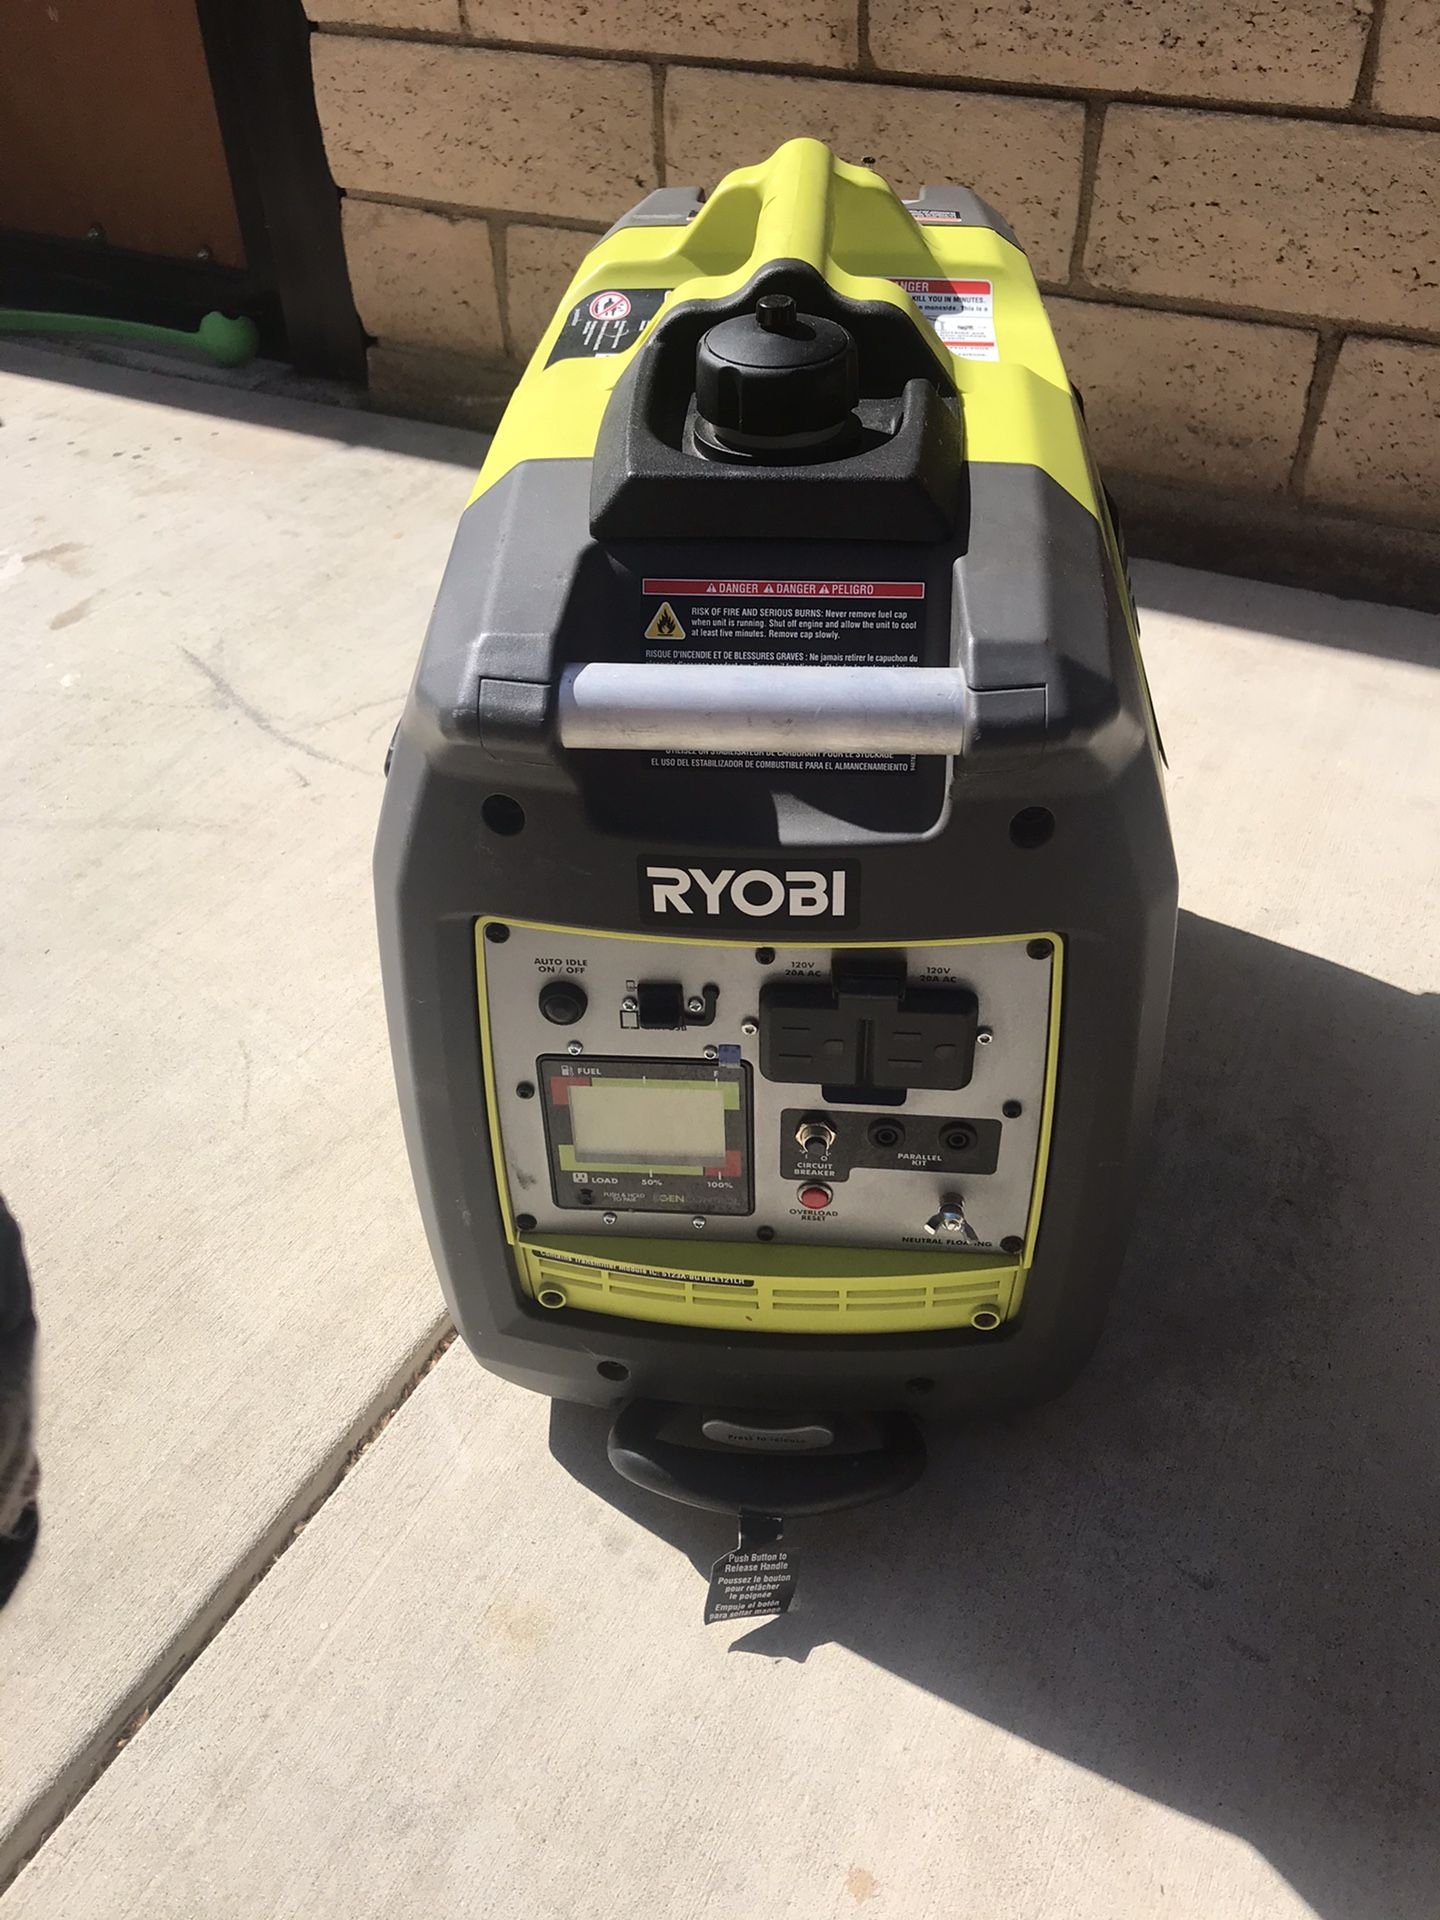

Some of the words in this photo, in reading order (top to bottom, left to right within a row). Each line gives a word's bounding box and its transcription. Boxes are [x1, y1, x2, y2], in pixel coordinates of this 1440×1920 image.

[912, 295, 926, 303] KILL
[928, 295, 943, 303] YOU
[944, 295, 952, 303] IN
[719, 584, 759, 593] DANGER
[776, 584, 816, 594] DANGER
[832, 585, 874, 595] PELIGRO
[691, 607, 710, 616] RISK
[711, 607, 721, 616] OF
[723, 608, 740, 617] FIRE
[741, 608, 758, 617] AND
[759, 608, 793, 617] SERIOUS
[794, 609, 824, 618] BURNS:
[825, 610, 847, 618] Never
[848, 611, 877, 619] remove
[878, 610, 892, 618] fuel
[893, 611, 908, 620] cap
[712, 619, 727, 627] unit
[728, 619, 735, 627] is
[736, 620, 767, 628] running.
[768, 620, 786, 628] Shut
[787, 620, 797, 628] off
[798, 620, 823, 629] engine
[825, 620, 839, 628] and
[840, 620, 861, 629] allow
[862, 621, 874, 629] the
[875, 621, 891, 629] unit
[901, 621, 917, 629] cool
[735, 630, 767, 638] minutes.
[768, 630, 798, 638] Remove
[799, 631, 814, 639] cap
[814, 631, 841, 640] slowly.
[645, 650, 671, 658] RISQUE
[672, 650, 712, 659] D'INCENDIE
[713, 651, 722, 659] ET
[723, 651, 733, 659] DE
[733, 651, 775, 660] BLESSURES
[776, 652, 804, 661] GRAVES
[809, 653, 819, 661] Ne
[820, 653, 843, 662] jamais
[844, 654, 866, 662] retirer
[867, 654, 874, 662] le
[875, 654, 908, 663] capuchon
[909, 654, 918, 663] du
[651, 758, 660, 766] EL
[660, 758, 676, 766] USO
[676, 759, 690, 767] DEL
[691, 759, 744, 768] ESTABILIZADOR
[744, 760, 754, 768] DE
[755, 760, 804, 769] COMBUSTIBLE
[804, 761, 824, 770] PARA
[825, 762, 833, 770] EL
[646, 867, 846, 917] RYOBI
[534, 958, 563, 966] AUTO
[566, 959, 588, 967] IDLE
[791, 961, 815, 969] 120V
[785, 969, 804, 977] 20A
[897, 1153, 942, 1162] PARALLEL
[797, 1162, 833, 1170] CIRCUIT
[794, 1169, 836, 1177] BREAKER
[591, 1177, 619, 1185] LOAD
[707, 1181, 734, 1189] 100%
[789, 1208, 838, 1217] OVERLOAD
[902, 1236, 942, 1245] NEUTRAL
[728, 1554, 749, 1563] Push
[751, 1553, 777, 1562] Button
[725, 1563, 758, 1573] Release
[760, 1562, 789, 1571] Handle
[718, 1576, 752, 1585] Poussez
[753, 1575, 762, 1583] le
[763, 1574, 791, 1582] bouton
[725, 1585, 745, 1593] pour
[746, 1583, 780, 1592] relâcher
[729, 1592, 737, 1600] le
[739, 1592, 772, 1601] poignée
[715, 1603, 746, 1612] Empuje
[709, 1613, 728, 1621] para
[754, 1607, 781, 1615] mango
